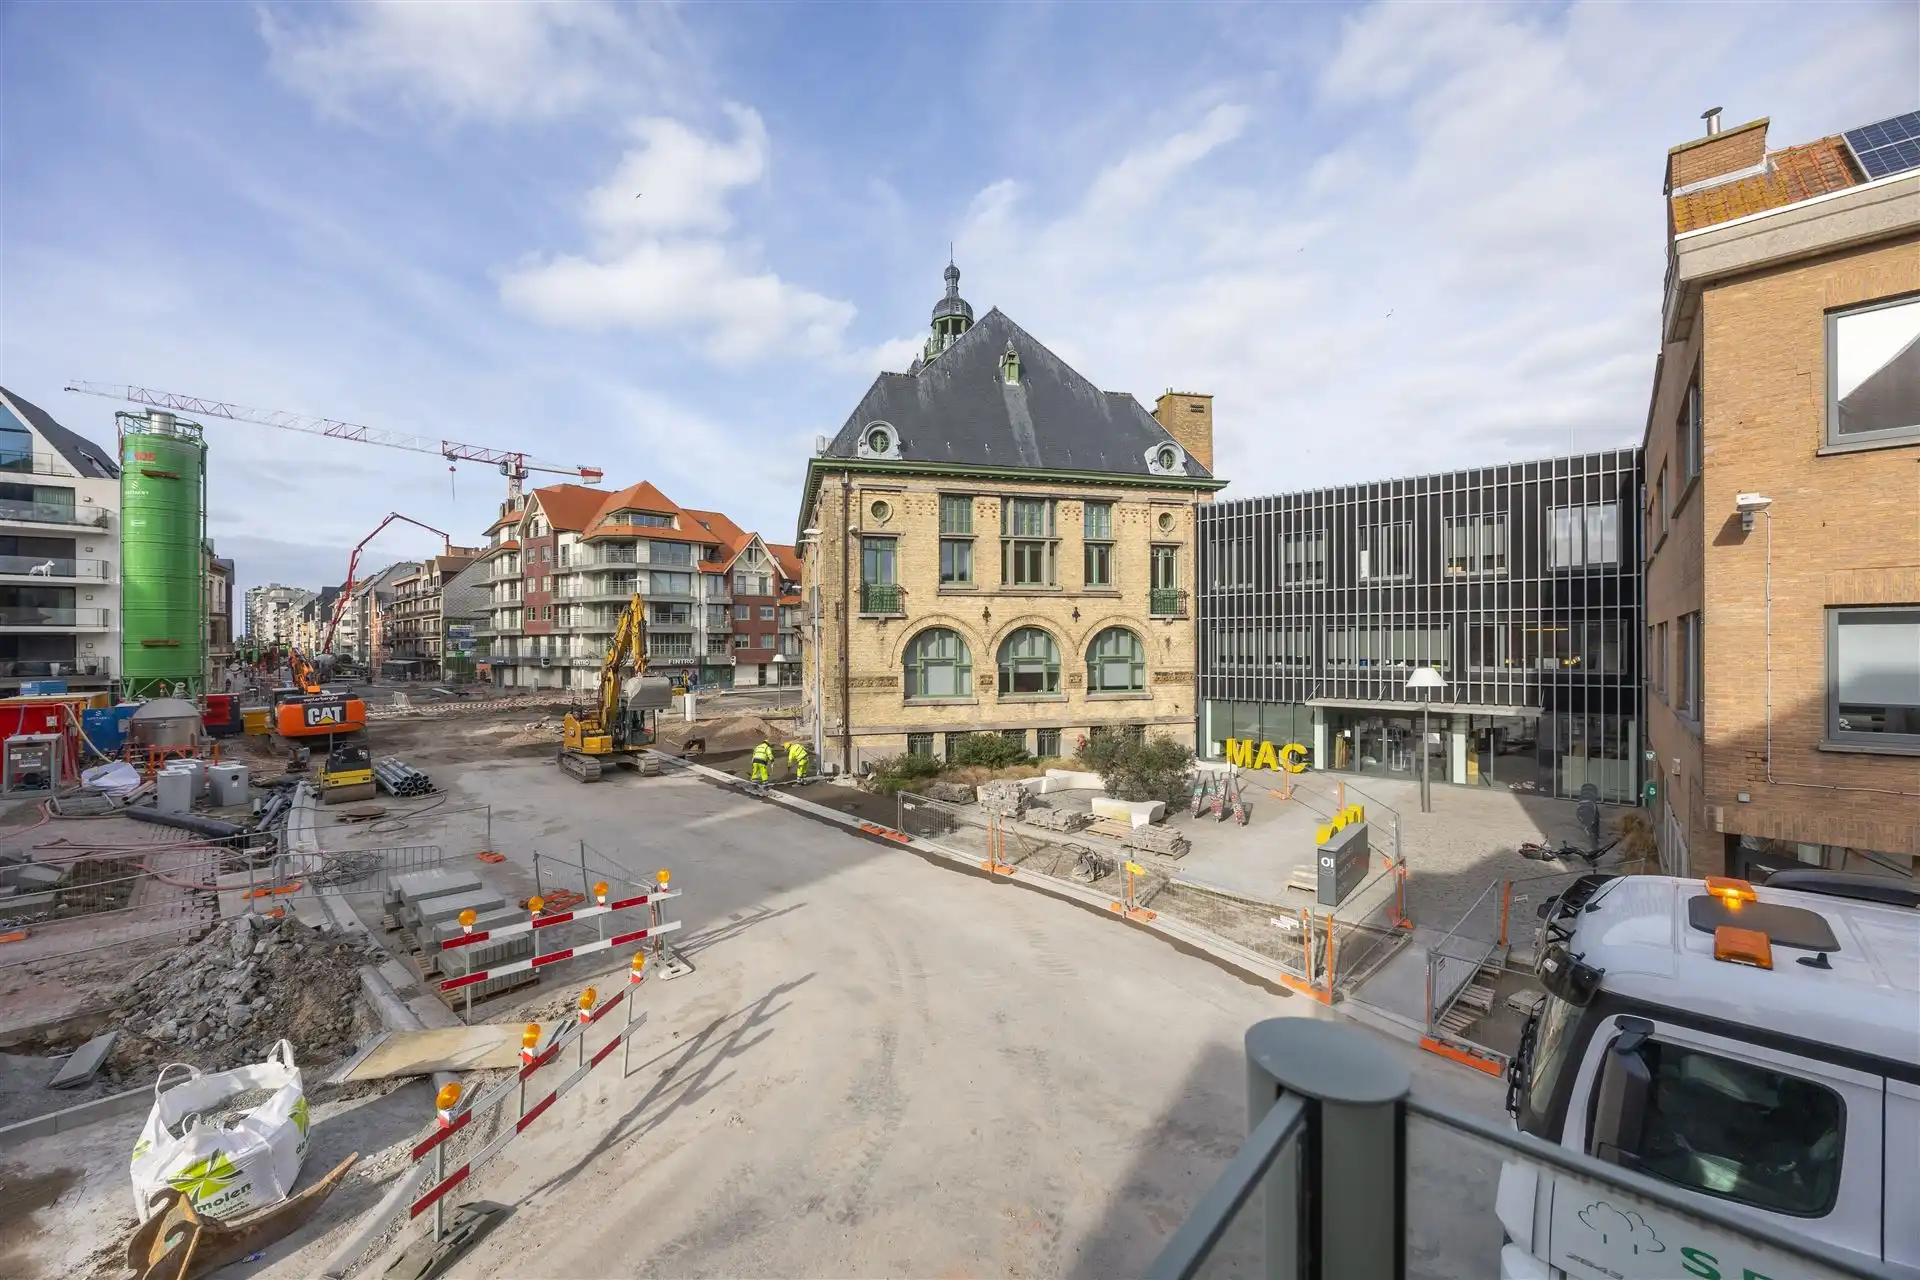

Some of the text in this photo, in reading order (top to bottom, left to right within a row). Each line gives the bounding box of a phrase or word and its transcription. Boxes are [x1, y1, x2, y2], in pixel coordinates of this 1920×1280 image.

[308, 706, 342, 725] CAT
[1226, 737, 1308, 773] MAC
[196, 1183, 251, 1213] molen
